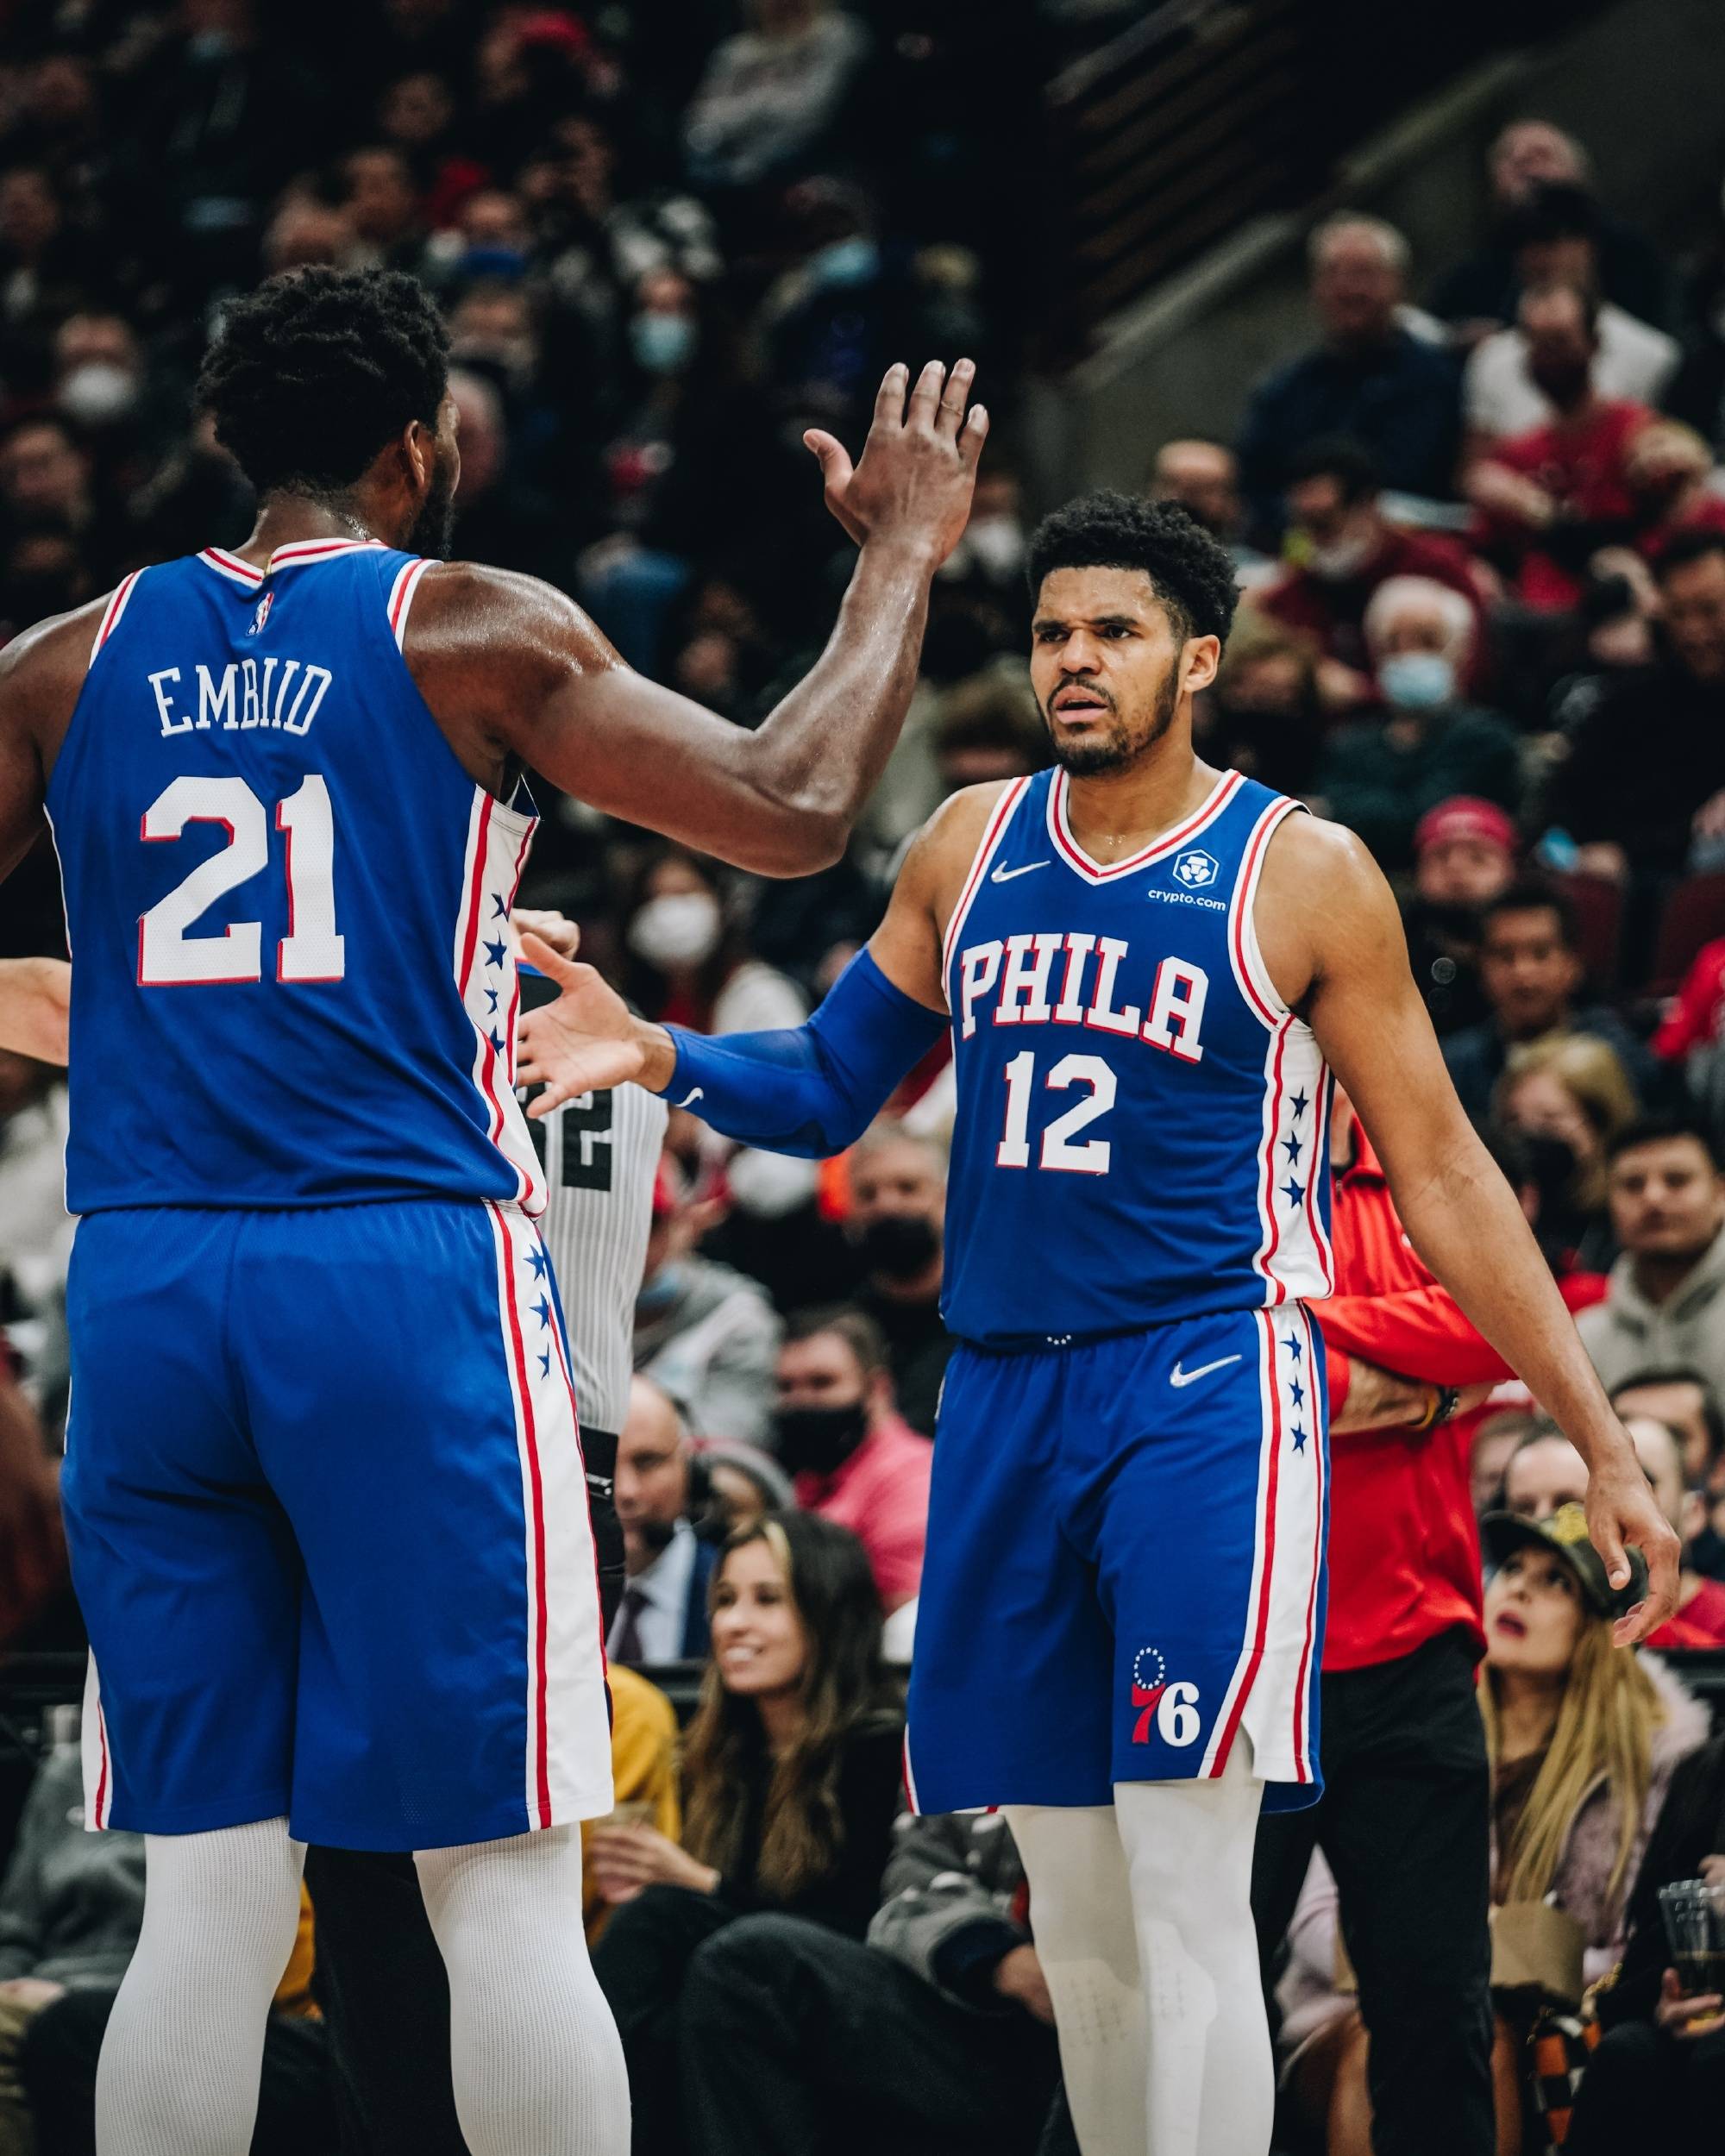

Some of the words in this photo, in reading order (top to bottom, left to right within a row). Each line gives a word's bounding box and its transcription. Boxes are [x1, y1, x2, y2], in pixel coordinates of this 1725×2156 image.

[147, 657, 333, 737] EMBIID
[137, 774, 345, 987] 21
[1148, 889, 1226, 911] crypto.com
[960, 932, 1209, 1064] PHILA
[995, 1050, 1118, 1176] 12
[1132, 1681, 1201, 1747] 76
